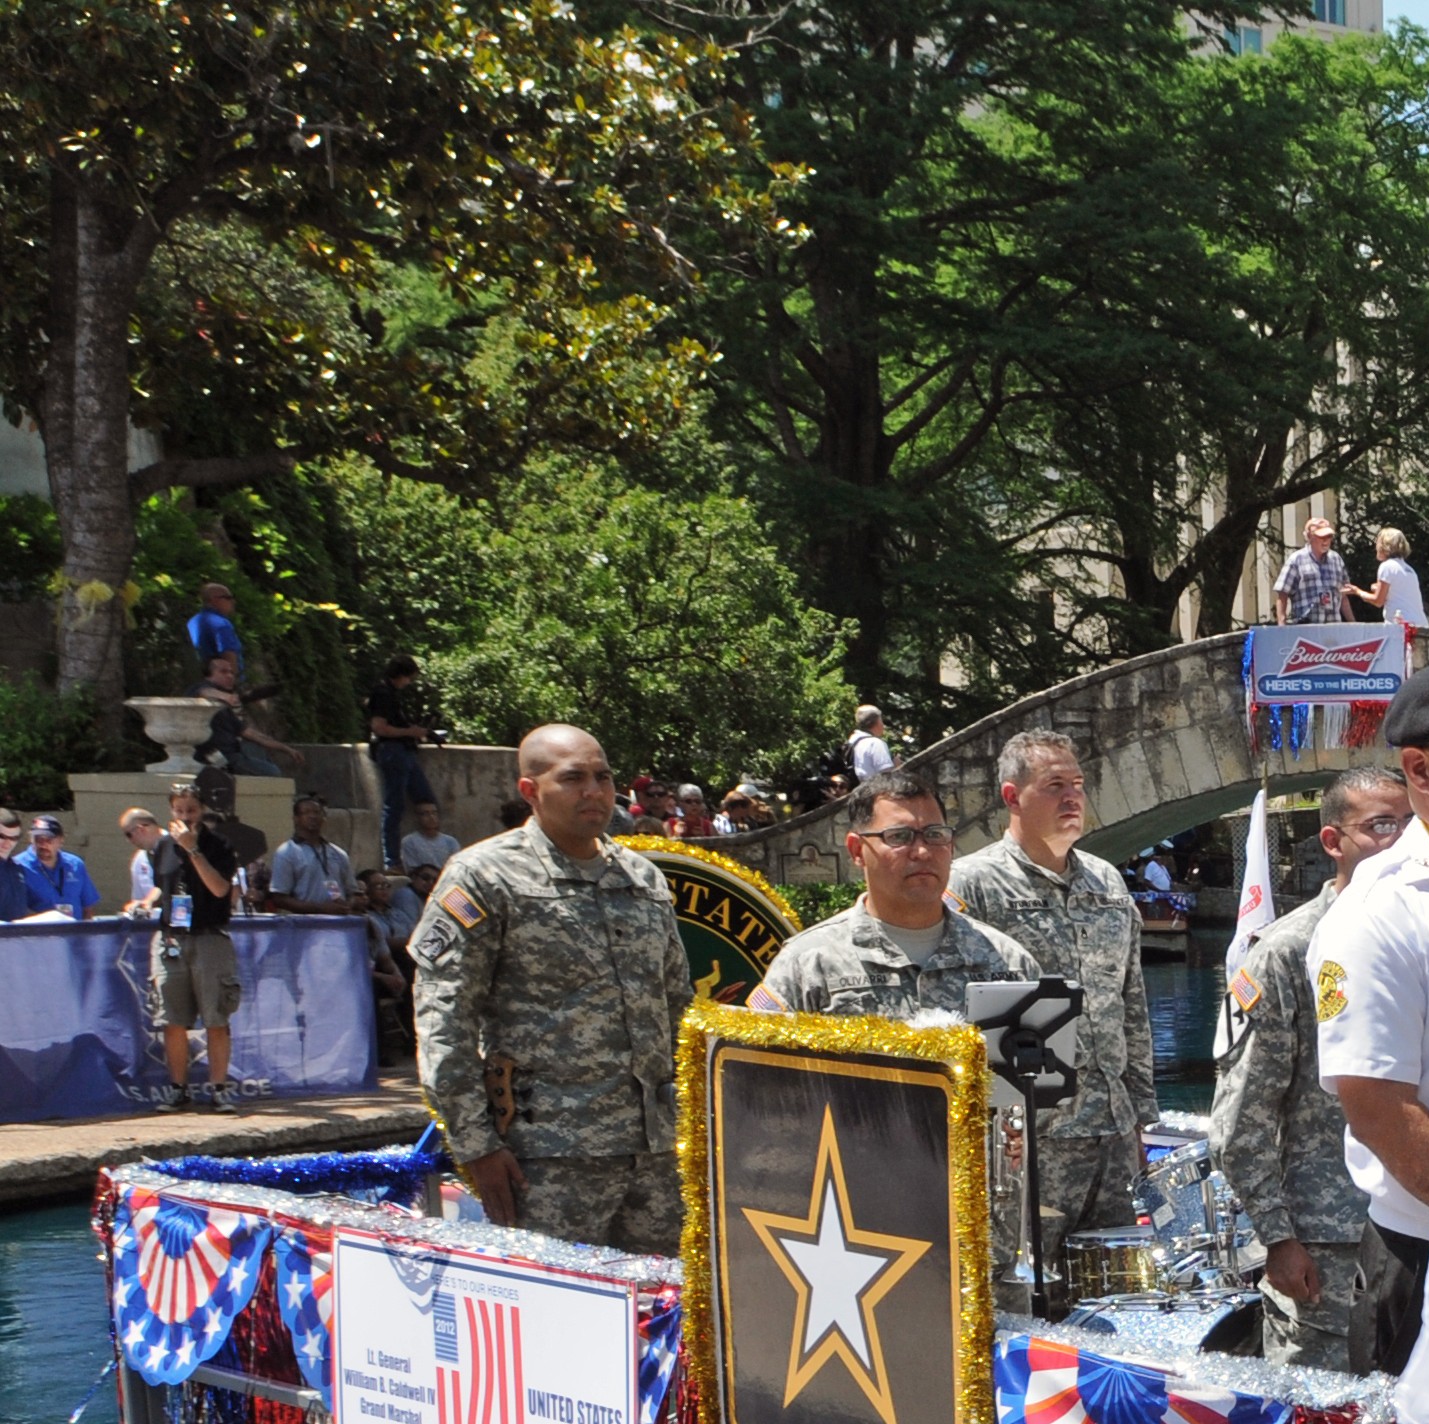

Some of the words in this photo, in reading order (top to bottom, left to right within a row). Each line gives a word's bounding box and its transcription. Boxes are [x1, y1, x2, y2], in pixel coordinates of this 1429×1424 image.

[1281, 647, 1382, 665] Budweiser
[1265, 679, 1312, 692] HERE'S
[1314, 681, 1325, 689] TO
[1341, 677, 1394, 691] HEROES
[664, 876, 782, 968] STATE
[469, 1280, 486, 1294] OUR
[487, 1283, 519, 1301] HEROES
[435, 1319, 456, 1336] 2012
[378, 1350, 411, 1374] General
[343, 1368, 378, 1391] William
[389, 1378, 426, 1403] Caldwell
[360, 1396, 386, 1419] Grand
[527, 1388, 574, 1424] UNITED
